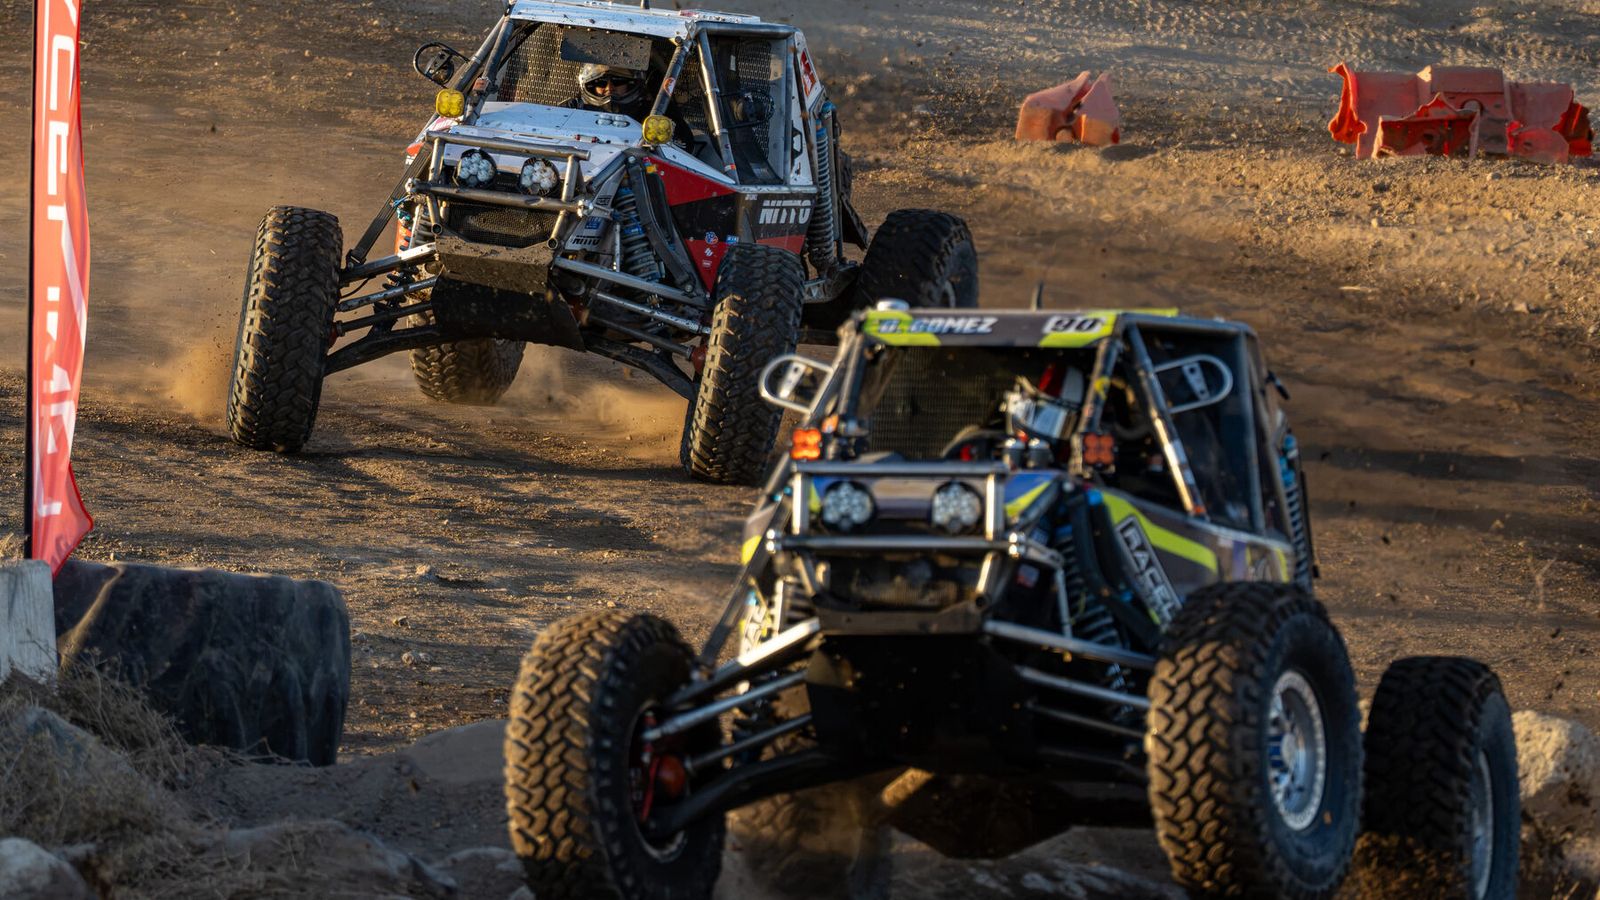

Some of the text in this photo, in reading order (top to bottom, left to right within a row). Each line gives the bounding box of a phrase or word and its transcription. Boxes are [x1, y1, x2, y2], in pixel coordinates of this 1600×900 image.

[758, 199, 812, 225] NITTO
[909, 317, 999, 335] GOMEZ
[1050, 317, 1101, 333] 90
